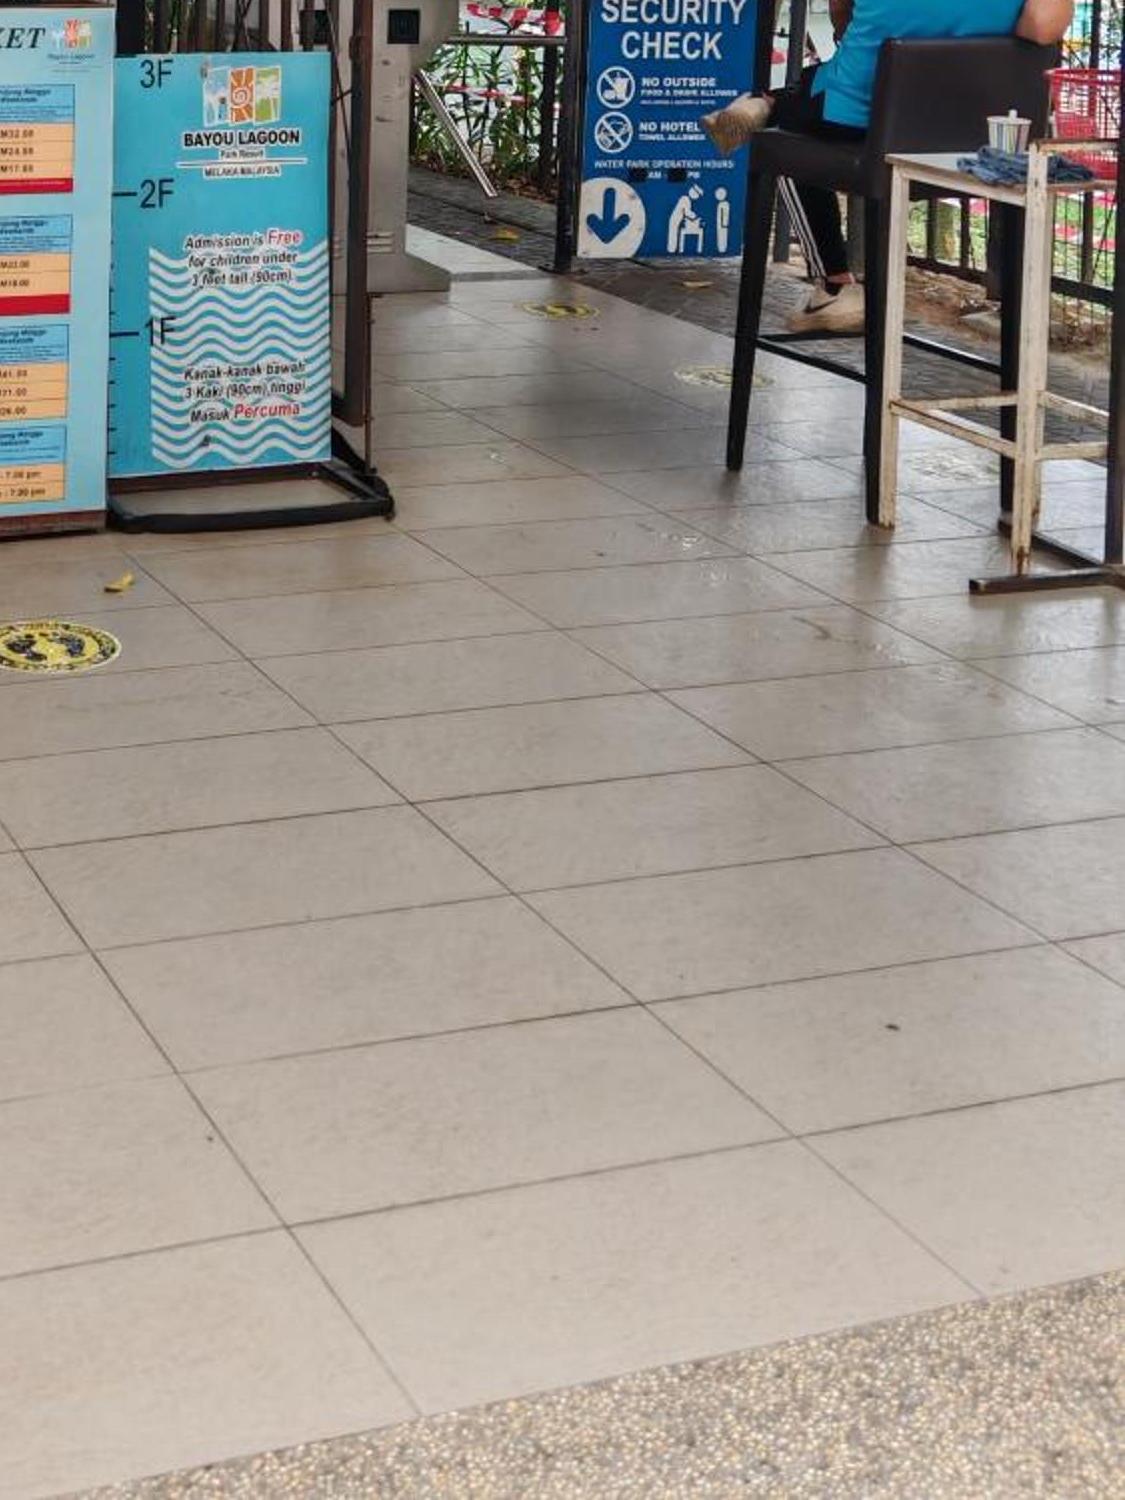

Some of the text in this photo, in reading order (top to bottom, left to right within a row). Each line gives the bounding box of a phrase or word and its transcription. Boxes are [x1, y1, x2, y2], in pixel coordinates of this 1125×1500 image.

[622, 32, 723, 60] CHECK
[140, 60, 173, 88] 3F
[641, 78, 716, 87] NO OUTSIDE
[641, 89, 665, 97] FOOD
[640, 122, 701, 132] NO HOTEL
[184, 130, 300, 146] BAYOU LAGOON
[205, 167, 238, 176] MELAKA
[627, 161, 650, 169] PARK
[652, 160, 701, 169] OPERATION
[704, 160, 734, 169] HOURS
[140, 179, 174, 208] 2F
[185, 230, 300, 248] Admission is Free
[189, 252, 298, 267] for children under
[230, 273, 248, 284] tall
[146, 317, 175, 346] 1F
[184, 363, 305, 380] Kanak-kanak bawah
[185, 388, 191, 398] 3
[191, 403, 300, 422] Masuk Percuma
